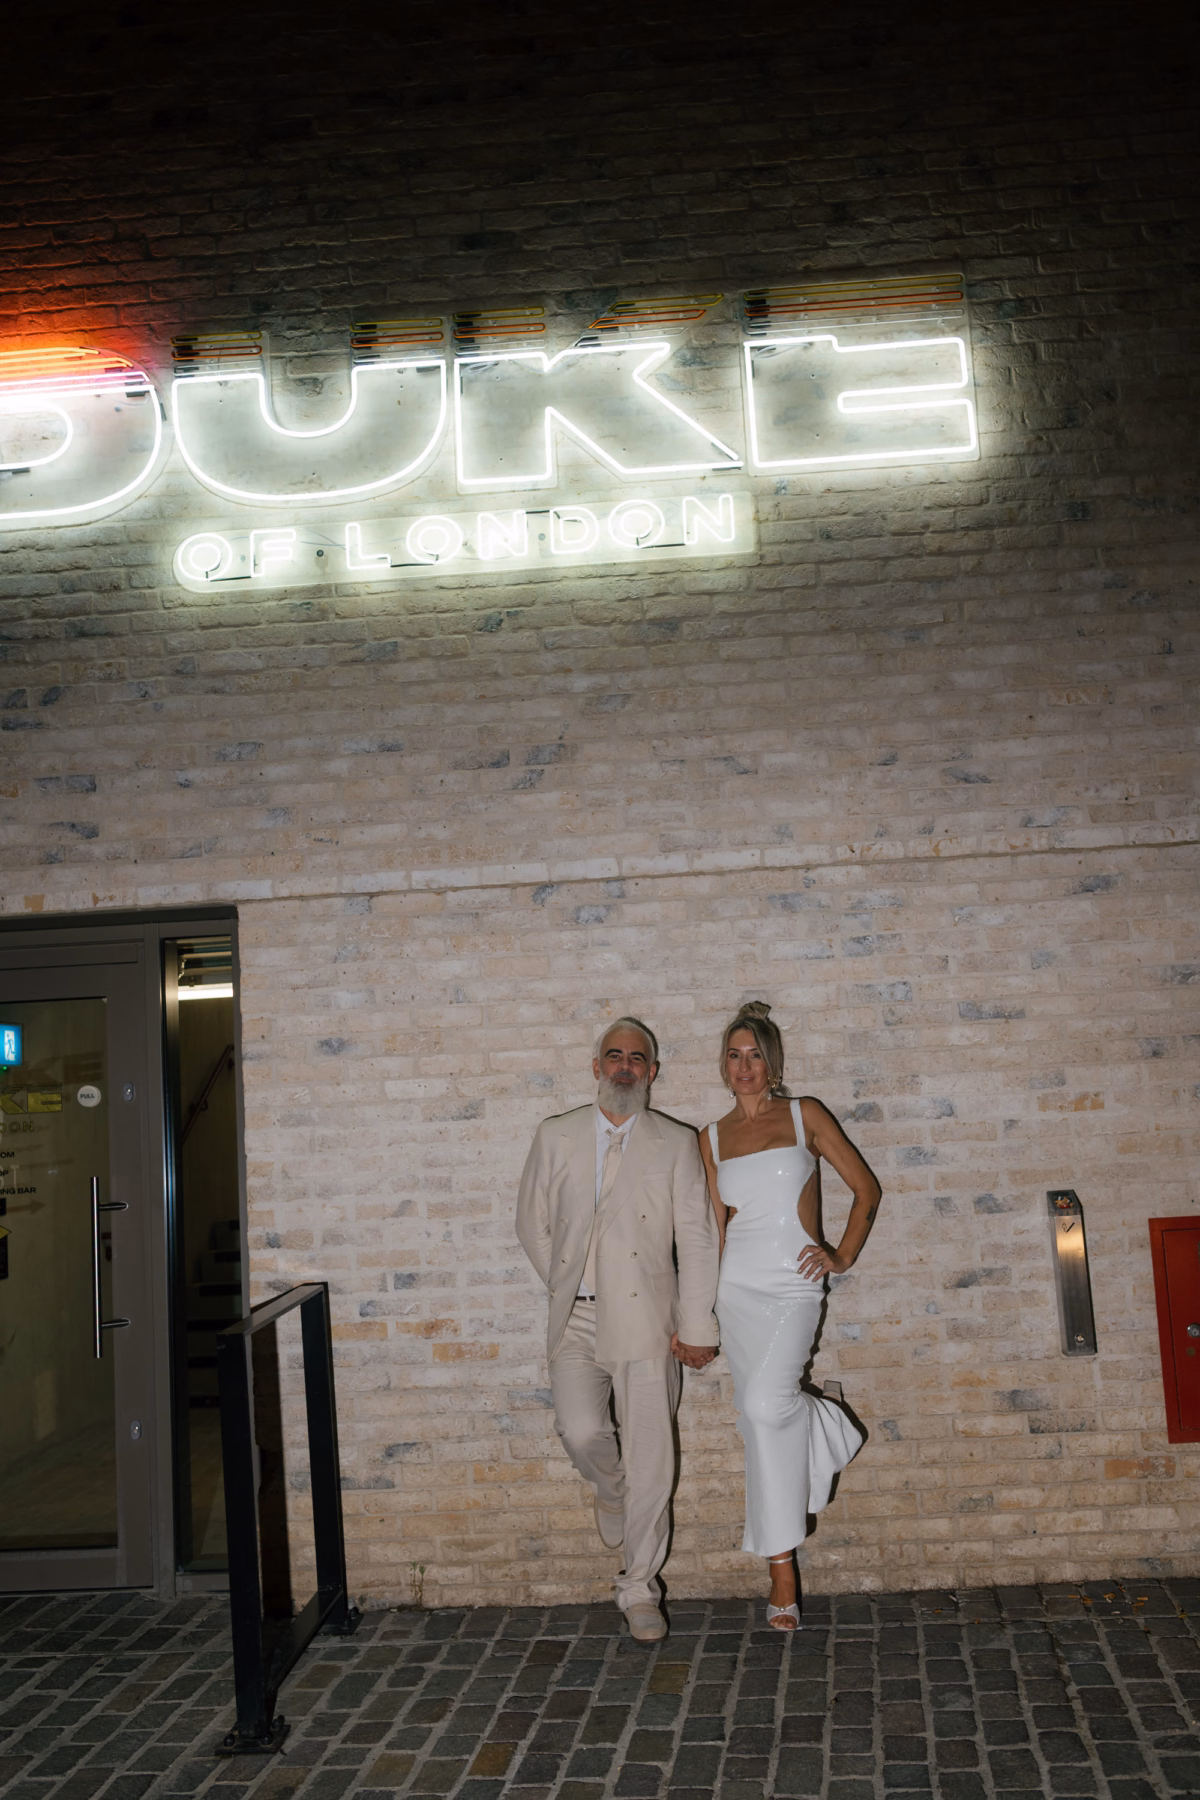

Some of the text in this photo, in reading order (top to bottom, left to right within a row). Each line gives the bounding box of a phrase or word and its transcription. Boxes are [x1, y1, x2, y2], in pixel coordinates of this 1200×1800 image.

[177, 492, 737, 583] OF LONDON
[0, 1085, 63, 1115] KE
[0, 1120, 34, 1133] DON
[0, 1151, 15, 1159] OM
[0, 1186, 37, 1196] ING BAR
